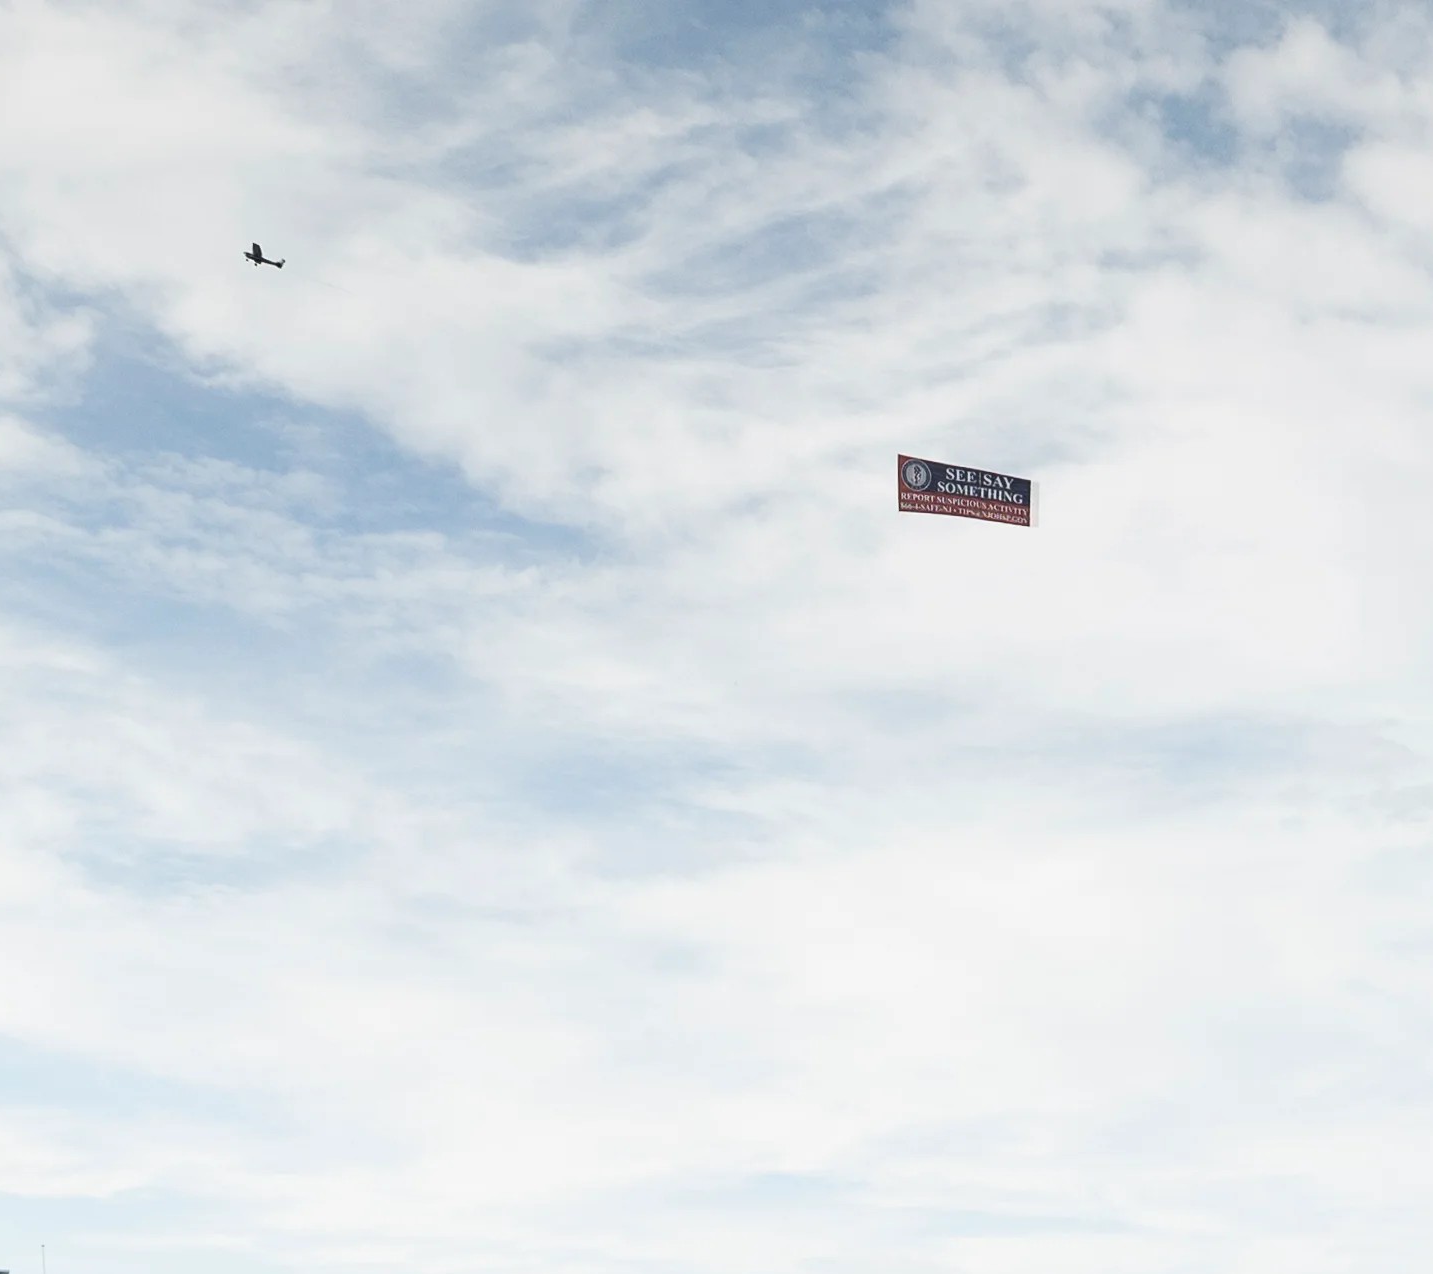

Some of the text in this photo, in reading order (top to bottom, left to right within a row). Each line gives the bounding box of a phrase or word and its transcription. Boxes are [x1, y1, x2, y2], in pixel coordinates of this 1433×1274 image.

[945, 467, 1014, 489] SEE SAY
[900, 492, 1028, 516] REPORT SUSPICIOUS ACTIVITY
[937, 481, 1023, 504] SOMETHING
